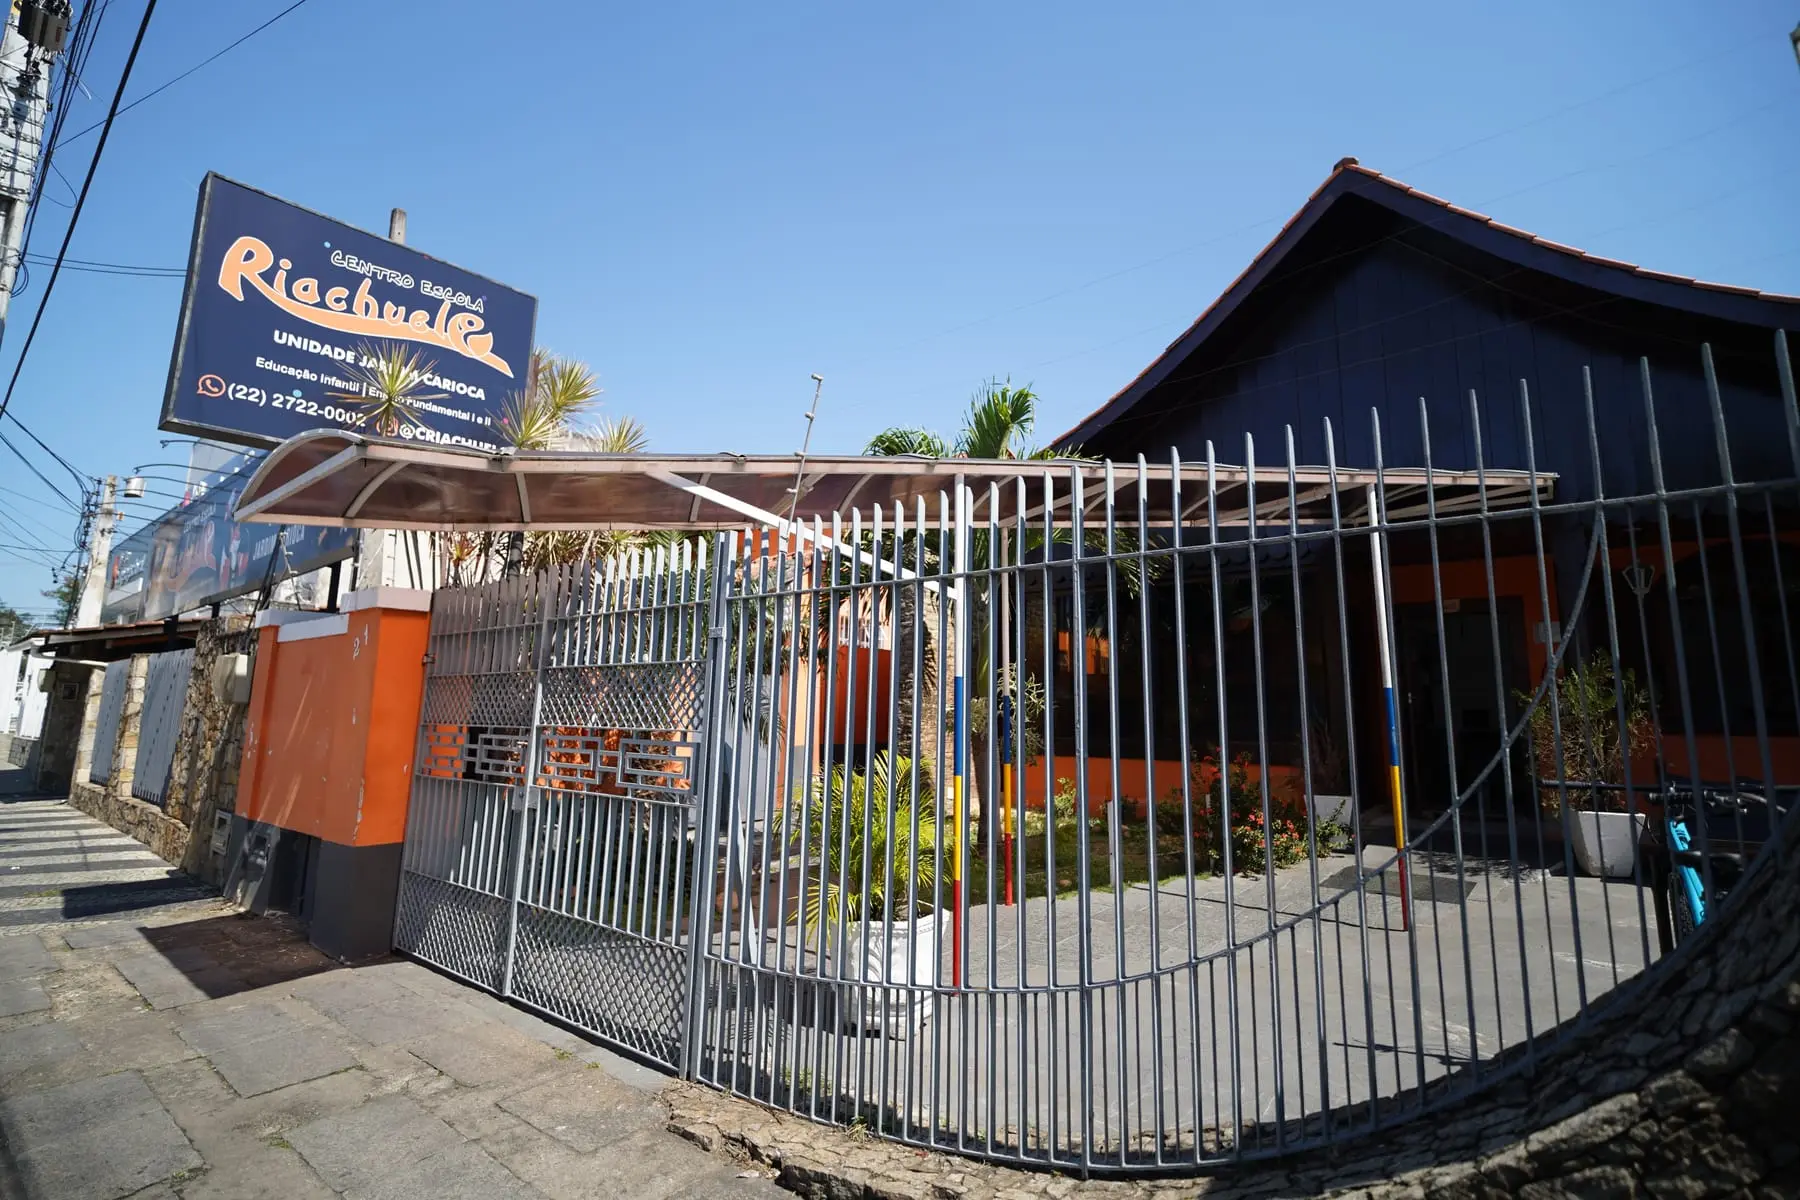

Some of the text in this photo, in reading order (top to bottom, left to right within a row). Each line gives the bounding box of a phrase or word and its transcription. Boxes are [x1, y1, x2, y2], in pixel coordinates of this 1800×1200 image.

[330, 250, 485, 313] CENTRO ESCOLA
[255, 356, 318, 381] Educação
[320, 373, 360, 393] Infantil
[273, 330, 356, 364] UNIDADE
[422, 372, 486, 401] CARIOCA
[227, 383, 367, 427] (22) 2722-0002
